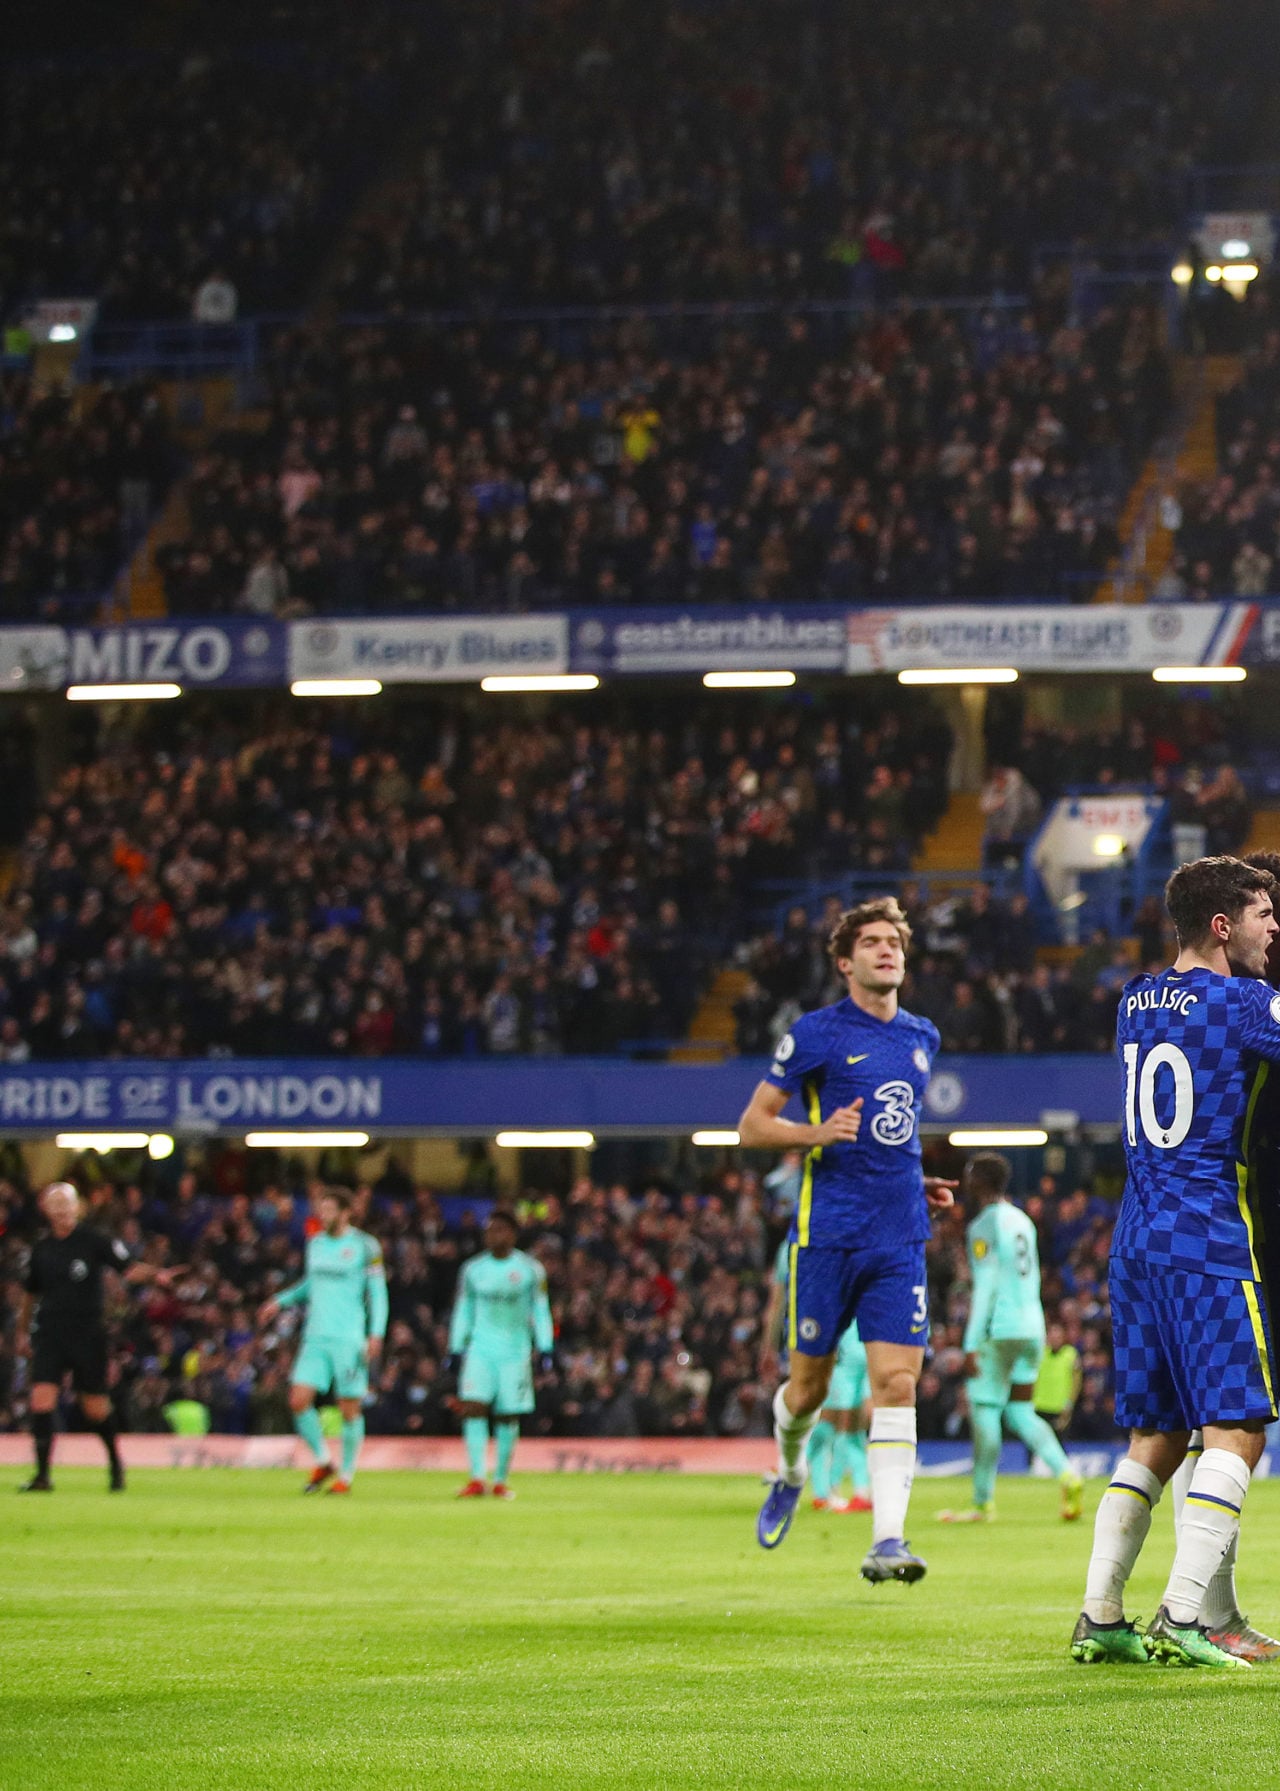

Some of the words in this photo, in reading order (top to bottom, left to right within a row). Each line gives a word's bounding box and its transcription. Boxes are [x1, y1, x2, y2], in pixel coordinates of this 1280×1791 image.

[353, 634, 448, 670] Kerry
[456, 630, 557, 664] Blues
[1126, 987, 1198, 1018] PULISIC
[0, 1077, 111, 1119] RIDE
[119, 1077, 169, 1105] OF
[176, 1076, 382, 1119] LONDON
[1123, 1042, 1194, 1149] 10
[911, 1284, 927, 1323] 3
